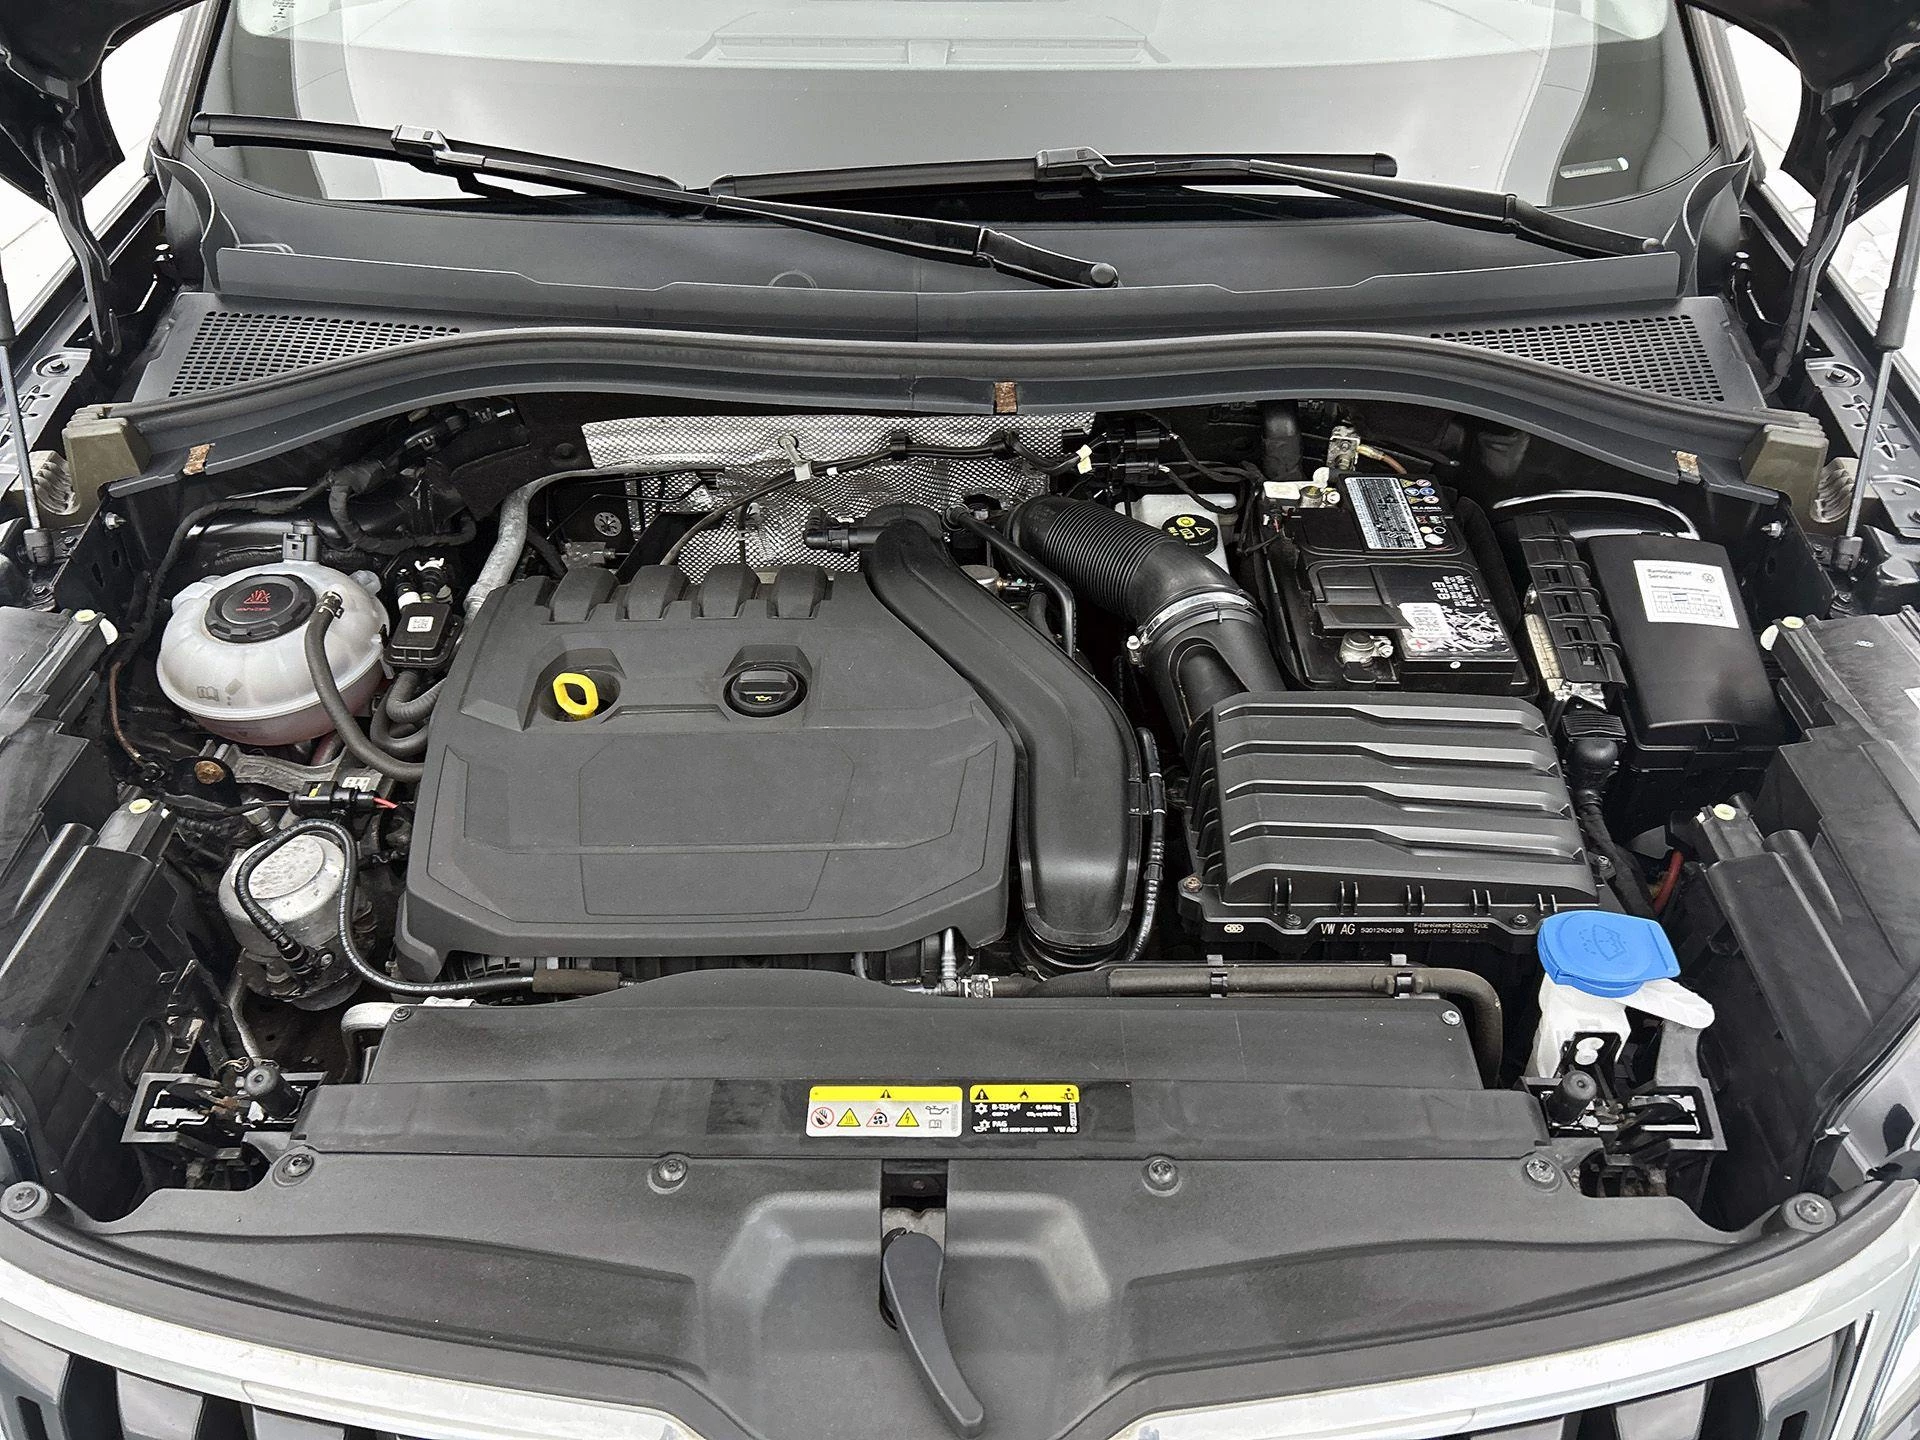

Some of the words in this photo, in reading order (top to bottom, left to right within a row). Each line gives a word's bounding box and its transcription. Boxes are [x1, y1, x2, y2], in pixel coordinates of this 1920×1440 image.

[1431, 581, 1451, 600] EFB
[1320, 923, 1336, 935] VW
[1340, 923, 1356, 935] AG
